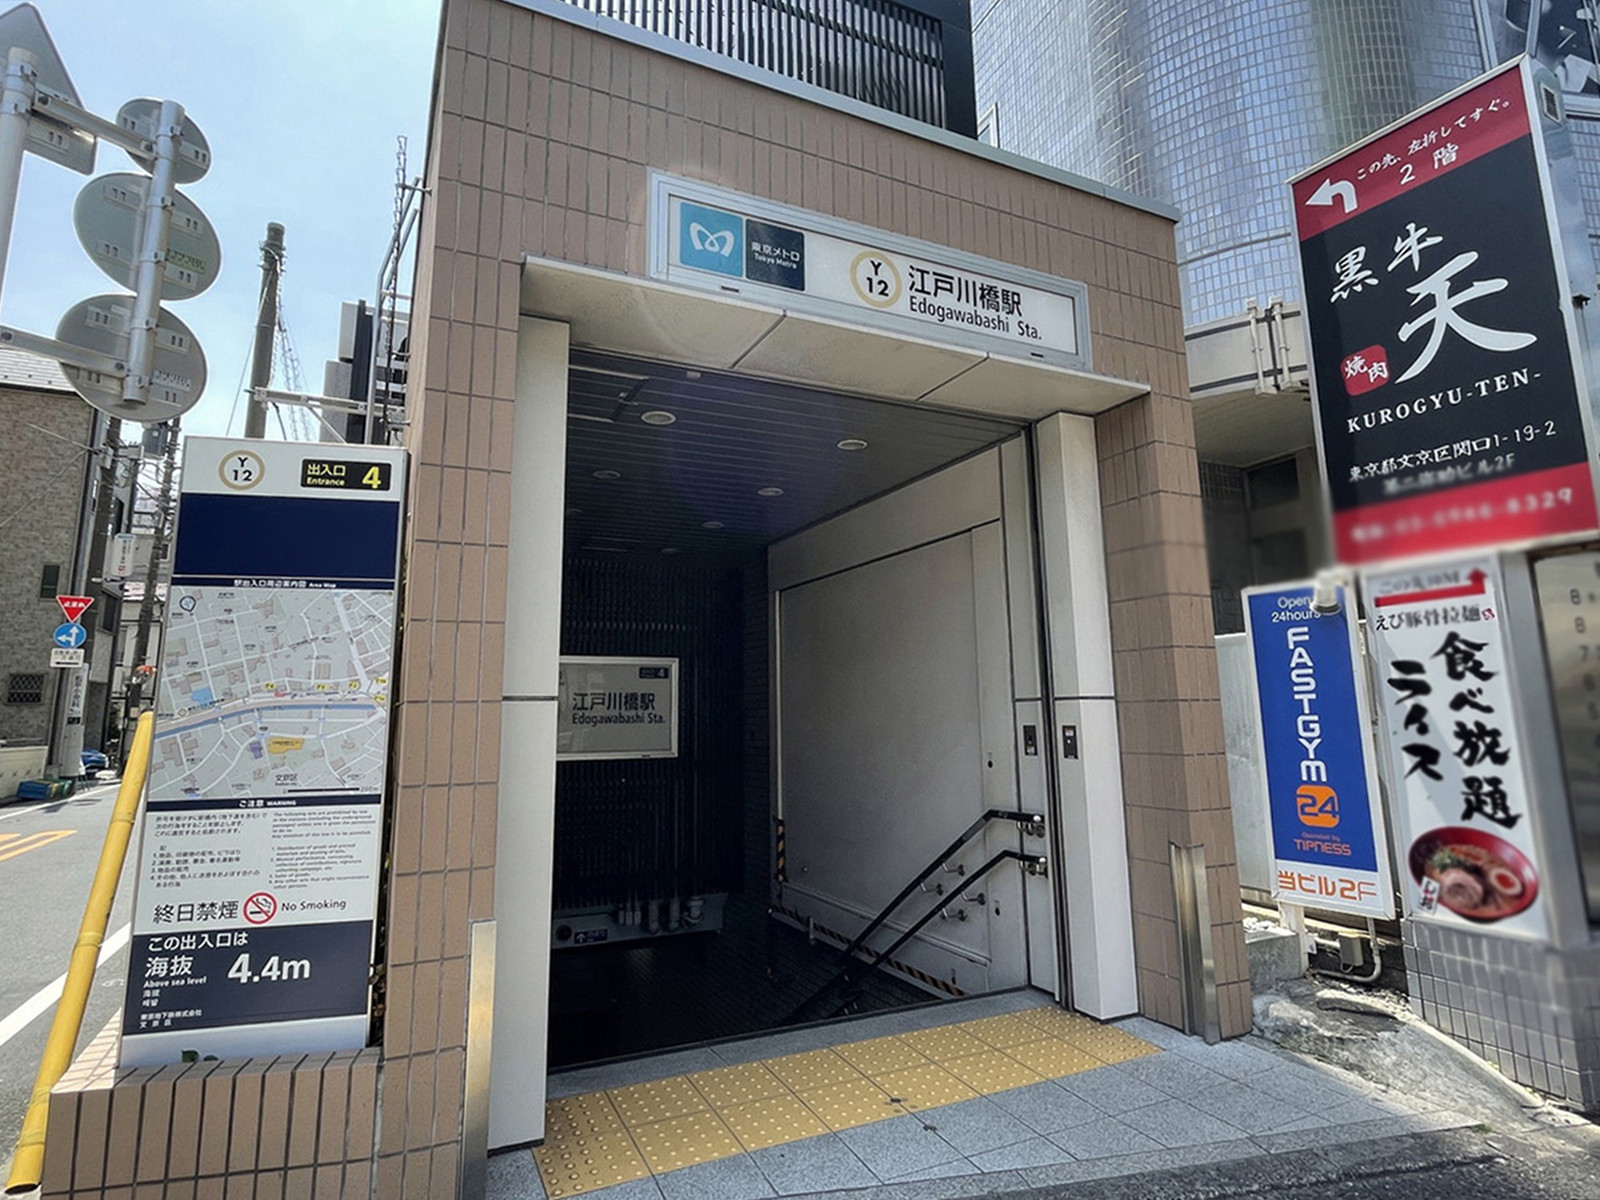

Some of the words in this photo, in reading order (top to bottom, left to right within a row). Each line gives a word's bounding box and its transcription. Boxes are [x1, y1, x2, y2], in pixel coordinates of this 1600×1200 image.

[1356, 98, 1510, 180] この先、左折してすぐ。
[751, 242, 800, 261] 東京メトロ
[754, 253, 775, 264] Tokyo
[776, 258, 797, 269] Metro
[870, 260, 882, 276] Y
[866, 276, 890, 297] 12
[908, 265, 1023, 317] 江戸川橋駅
[910, 295, 1010, 333] Edogawabashi
[1017, 320, 1043, 341] Sta.
[1345, 355, 1389, 383] 焼肉
[1346, 368, 1542, 434] KUROGYU-TEN-
[237, 456, 248, 467] Y
[307, 463, 346, 476] 出入口
[232, 469, 253, 481] 12
[306, 477, 345, 486] Entrance
[362, 466, 381, 489] 4
[1277, 596, 1312, 609] Open
[572, 692, 656, 711] 江戸川橋駅
[572, 712, 645, 727] Edogawabashi
[647, 713, 666, 724] Sta.
[1387, 660, 1444, 781] ライス
[1431, 631, 1523, 829] 食べ放題
[239, 799, 265, 808] ご注意
[1296, 794, 1340, 818] 24
[1293, 839, 1352, 856] TIPNESS
[1278, 870, 1377, 901] 当ビル2F
[153, 900, 239, 925] 終日禁煙
[281, 902, 297, 911] No
[300, 899, 347, 912] Smoking
[148, 931, 249, 952] この出入口は
[144, 954, 193, 978] 海抜
[227, 953, 311, 983] 4.4m
[143, 980, 170, 988] Above
[187, 976, 207, 984] level
